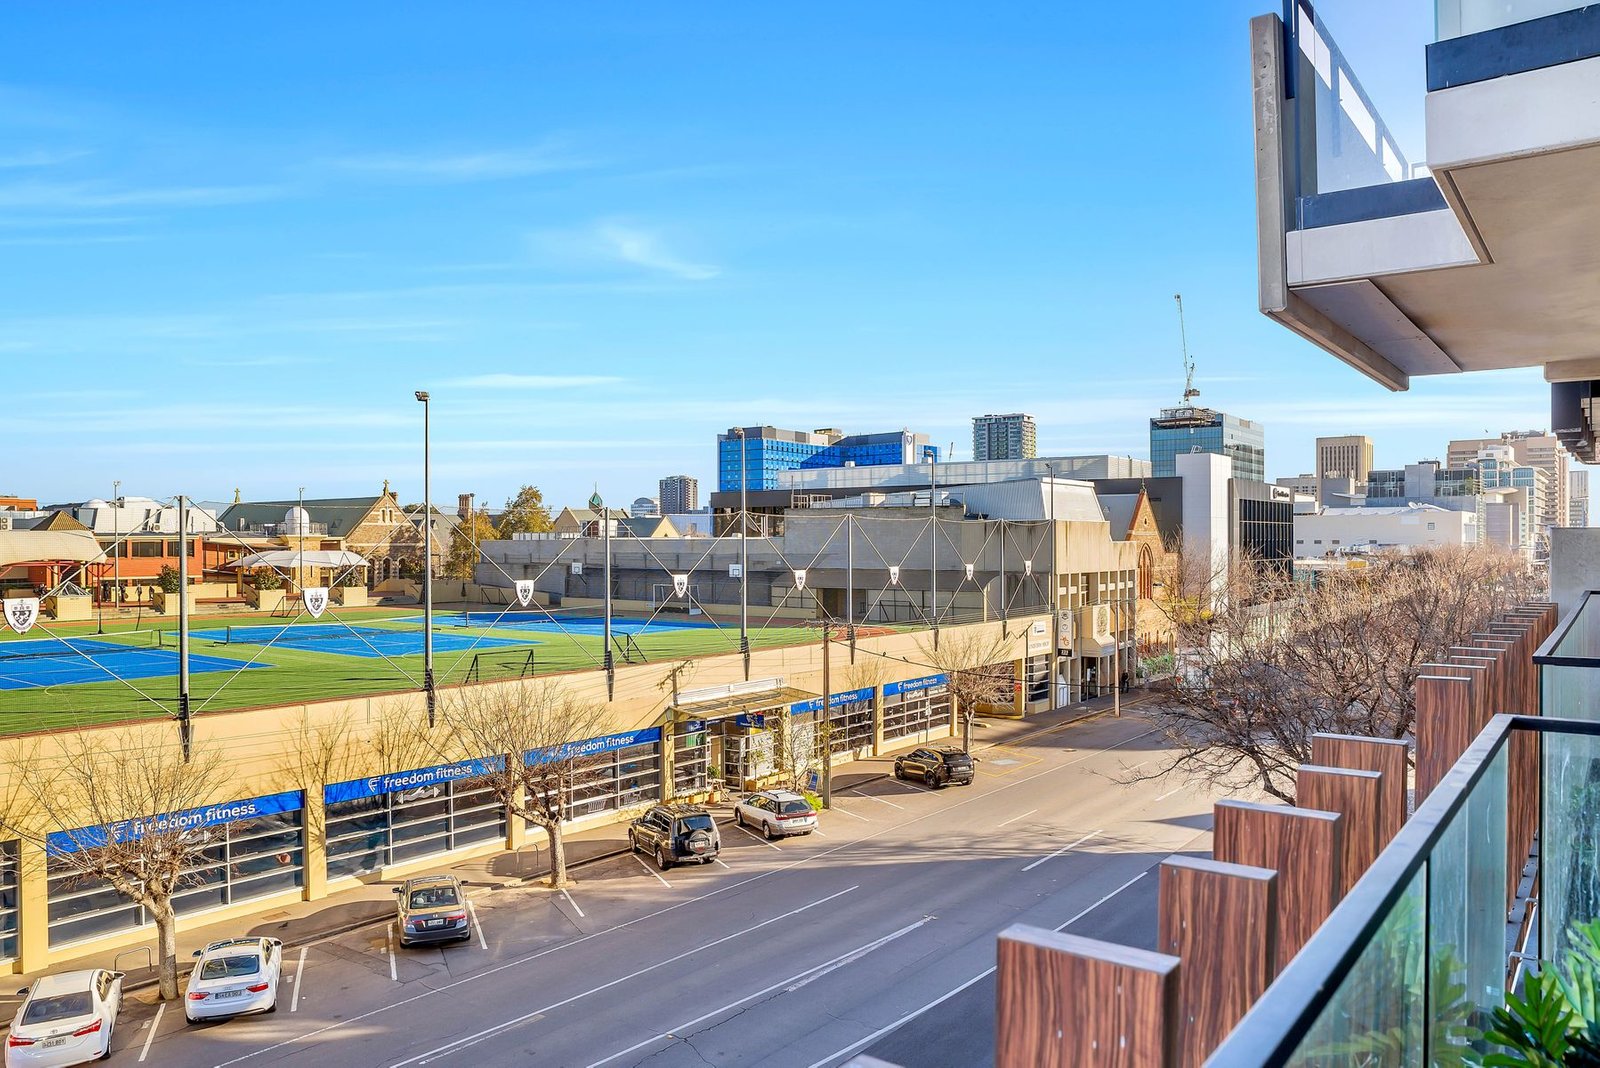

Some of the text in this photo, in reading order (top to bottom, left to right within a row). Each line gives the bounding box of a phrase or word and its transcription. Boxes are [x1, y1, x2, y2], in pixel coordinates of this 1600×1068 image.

[903, 680, 922, 689] freedom
[922, 677, 938, 686] fitness
[840, 692, 858, 703] fitness
[606, 735, 634, 748] fitness
[384, 773, 434, 789] freedom
[436, 765, 472, 779] fitness
[134, 812, 203, 835] freedom
[205, 804, 256, 821] fitness
